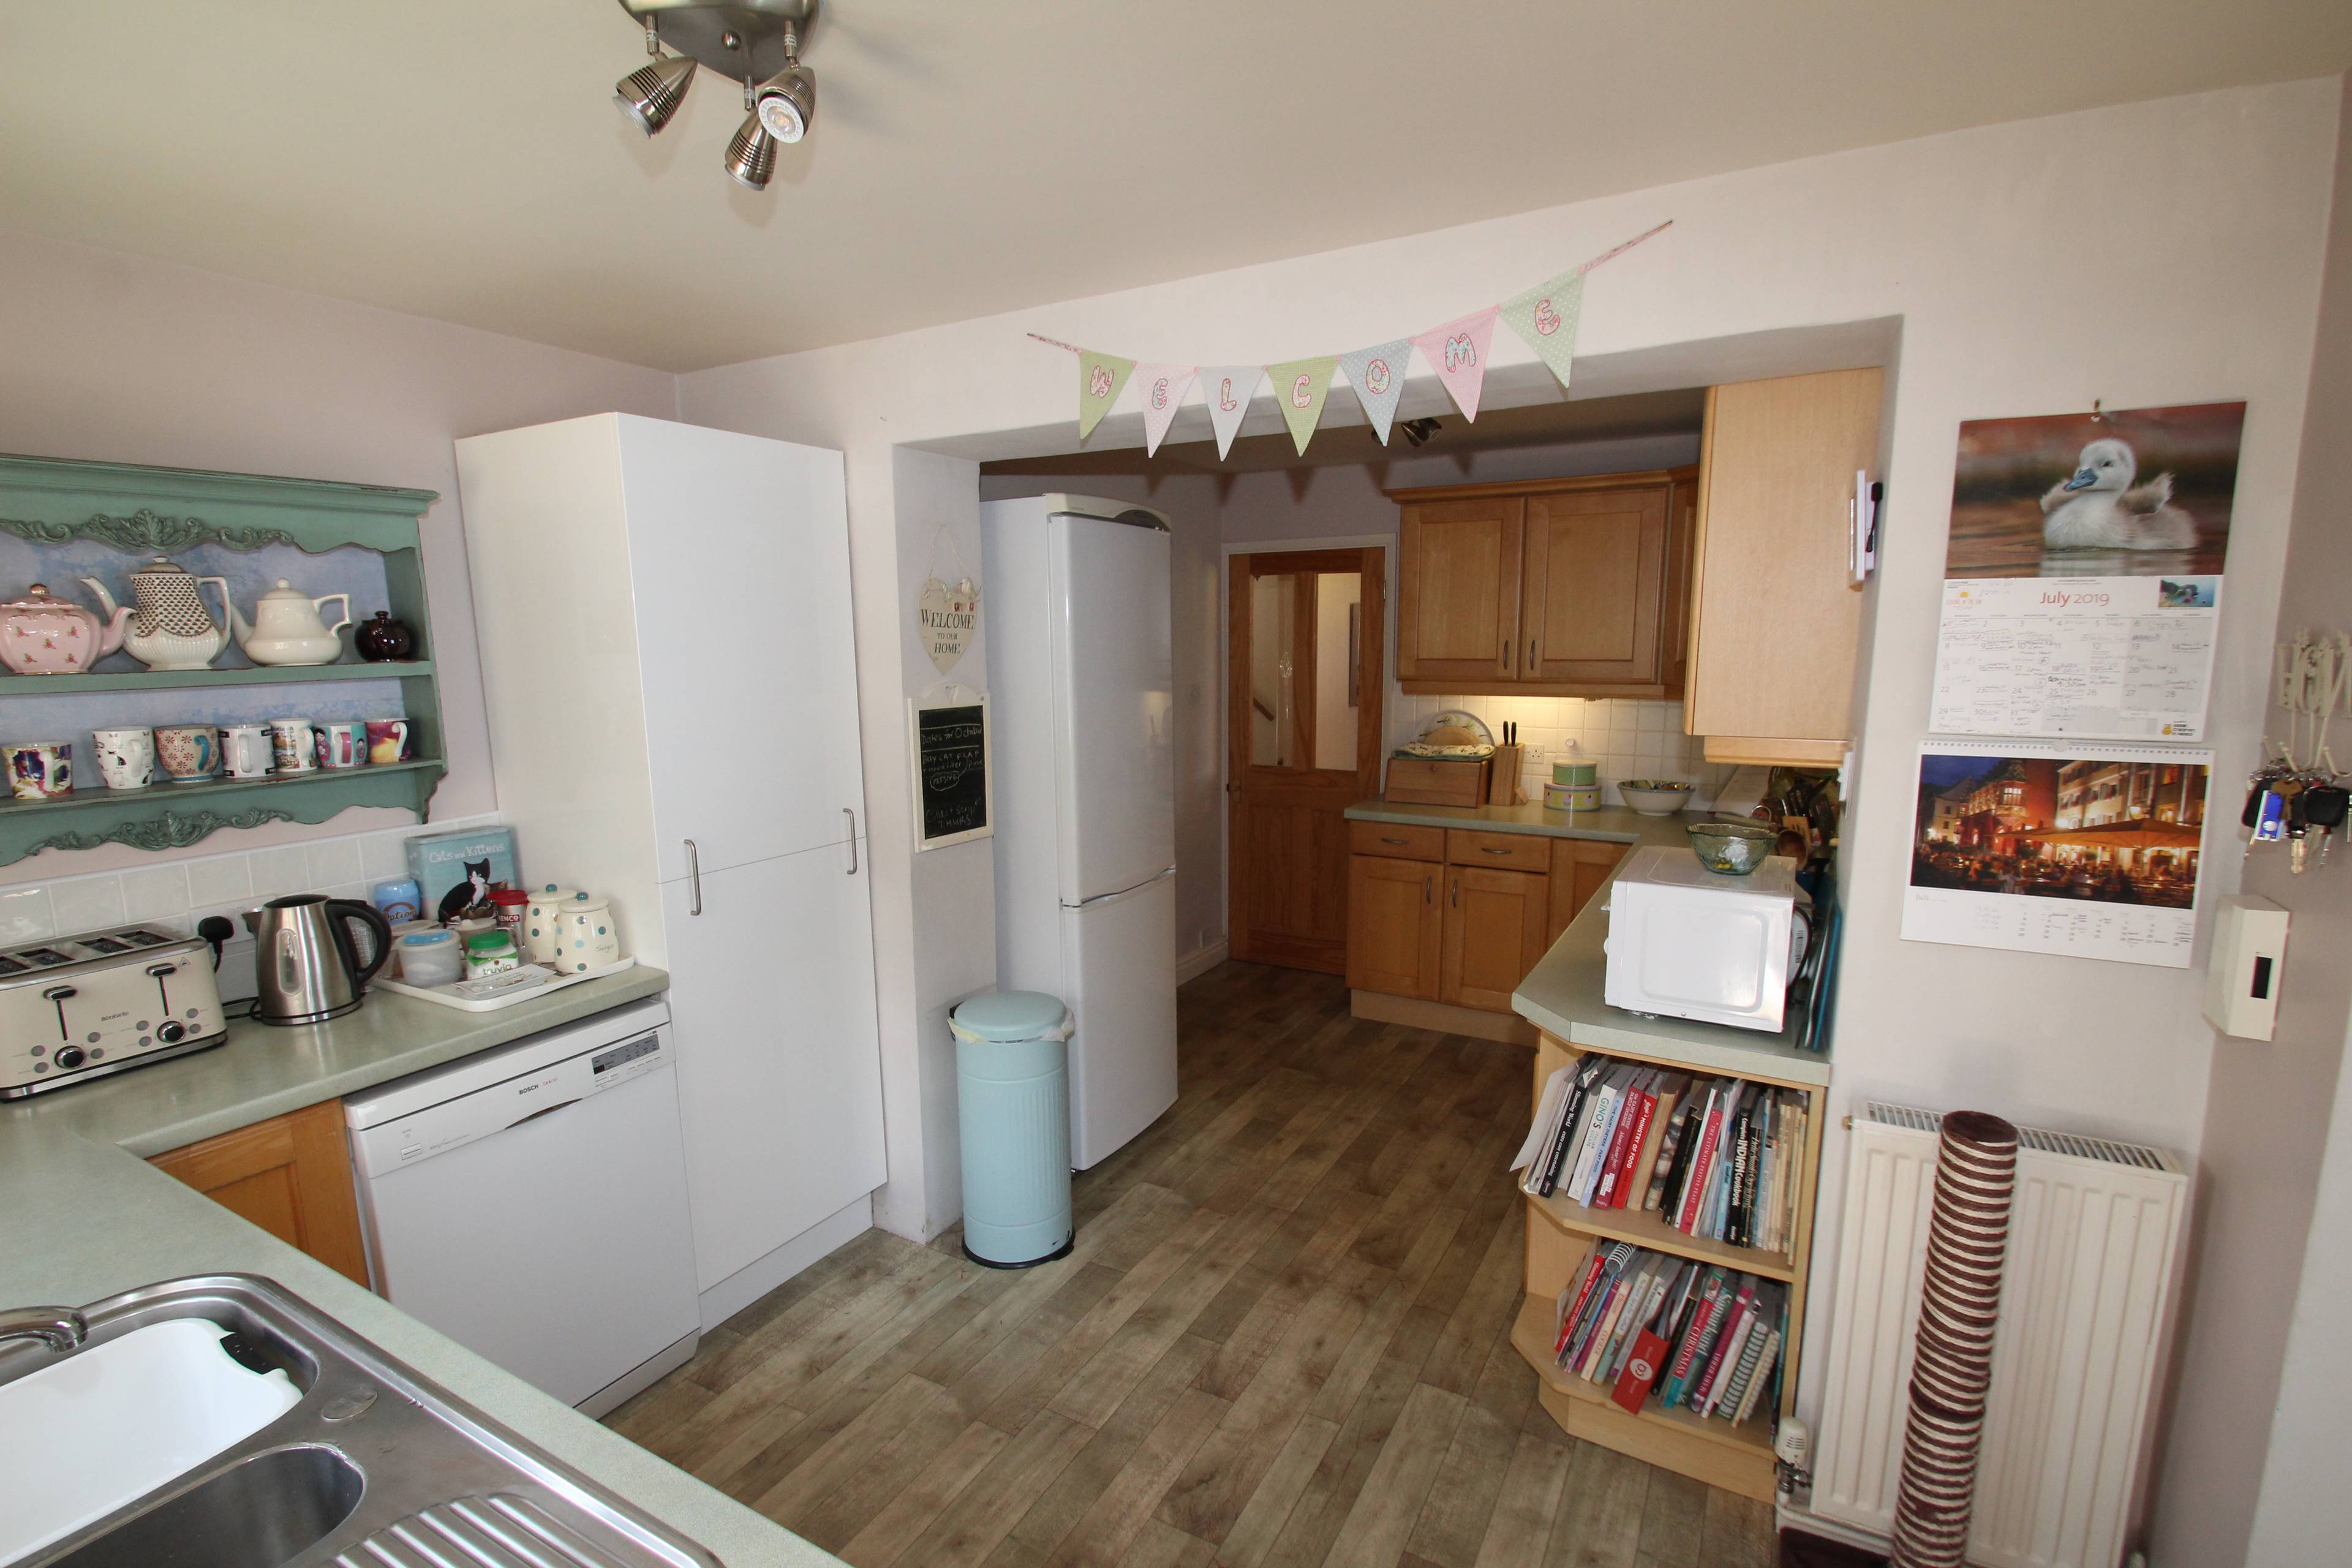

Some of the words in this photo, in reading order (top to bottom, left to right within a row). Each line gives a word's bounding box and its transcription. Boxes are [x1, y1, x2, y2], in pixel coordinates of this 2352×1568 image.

[2040, 591, 2070, 608] July
[2073, 594, 2109, 606] 2019
[921, 609, 974, 630] WELCOME
[935, 643, 960, 654] HOME
[957, 750, 980, 760] FLAP
[938, 815, 971, 829] THURS
[429, 851, 455, 863] Cats
[466, 843, 505, 857] Kittens
[482, 964, 512, 975] truvia
[519, 1084, 539, 1095] BOSCH
[1569, 1090, 1581, 1112] Slimming
[1565, 1113, 1575, 1127] World
[1593, 1098, 1610, 1129] GINO'S
[1635, 1117, 1646, 1144] MINISTRY
[1740, 1118, 1749, 1139] Complete
[1632, 1144, 1638, 1153] OF
[1703, 1136, 1713, 1164] ULTIMATE
[1735, 1139, 1748, 1173] INDIAN
[1548, 1151, 1559, 1177] entertaining
[1627, 1152, 1635, 1169] FOOD
[1695, 1164, 1705, 1186] FESTIVE
[1732, 1172, 1743, 1207] Cookbook
[1583, 1281, 1593, 1294] World
[1675, 1327, 1701, 1374] CHRISTMAS
